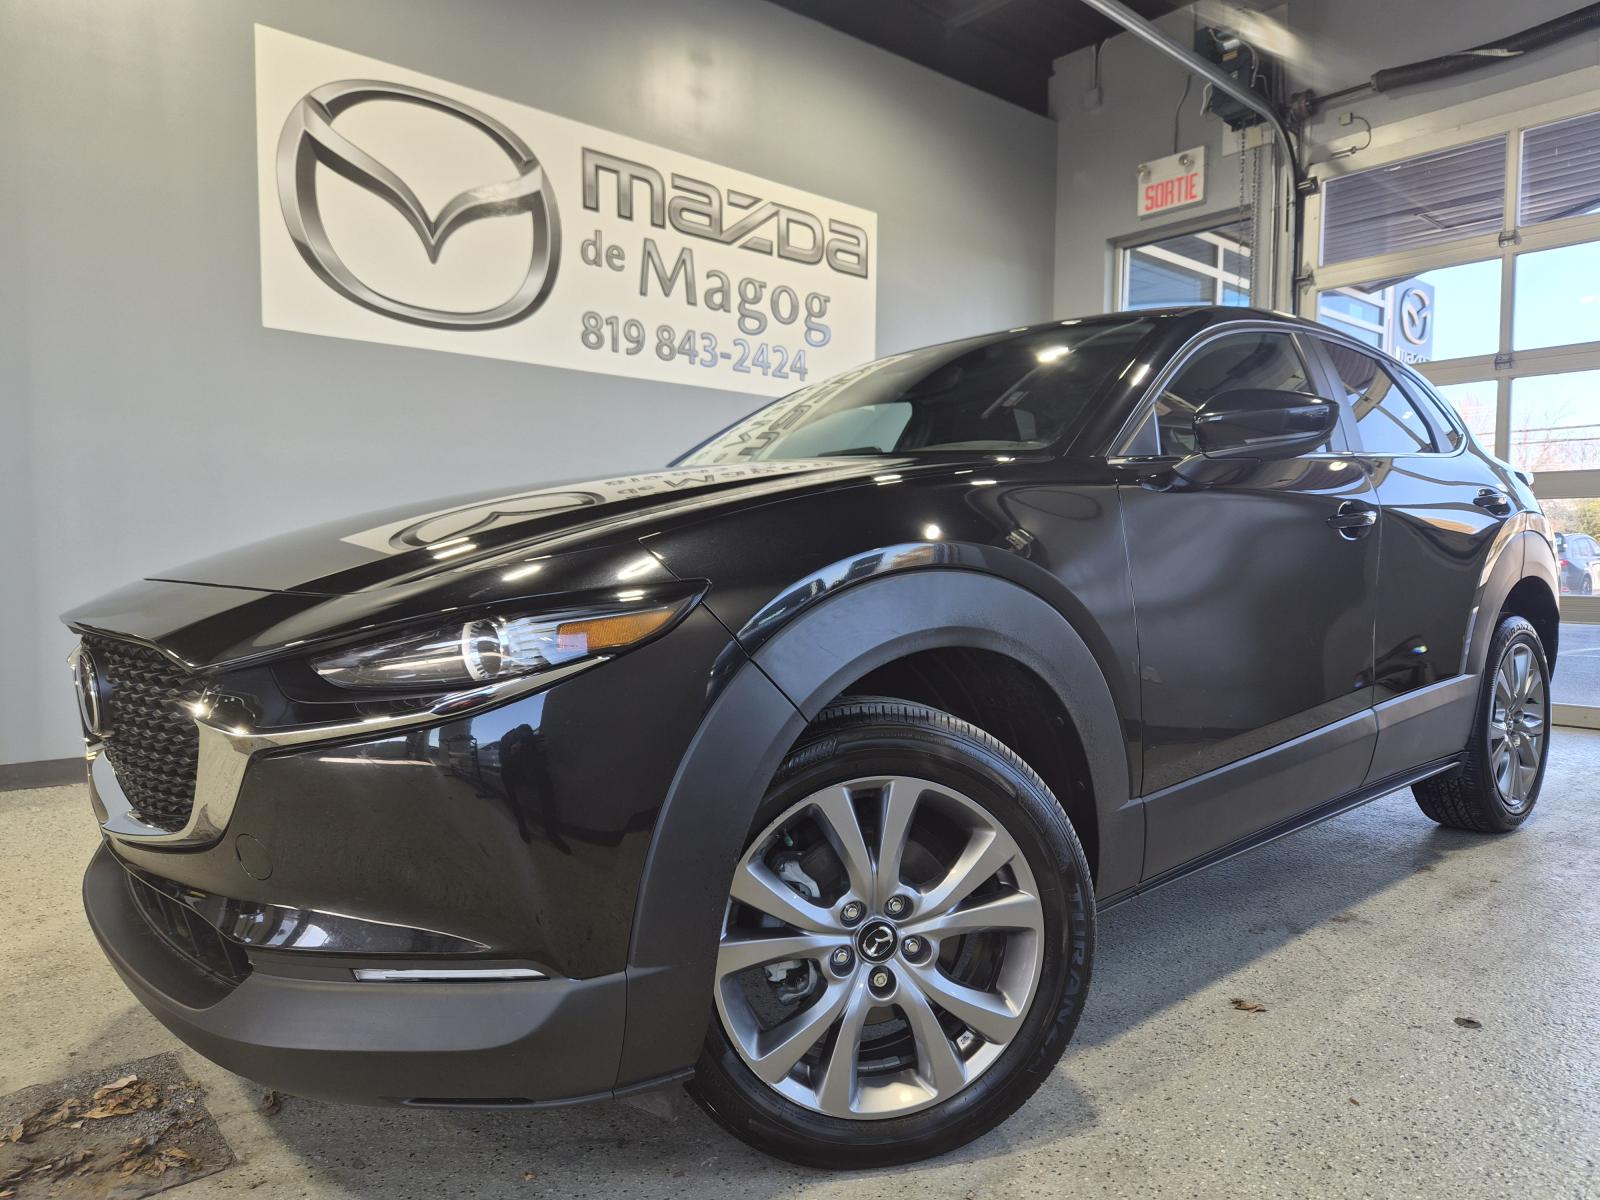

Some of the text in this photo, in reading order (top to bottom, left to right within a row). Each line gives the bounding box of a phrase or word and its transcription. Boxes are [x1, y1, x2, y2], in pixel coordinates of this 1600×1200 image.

[1144, 172, 1199, 211] SORTIE
[580, 229, 832, 347] de Magog
[581, 311, 808, 381] 819 843-2424
[1395, 345, 1430, 365] maz
[1504, 623, 1534, 643] URANZA
